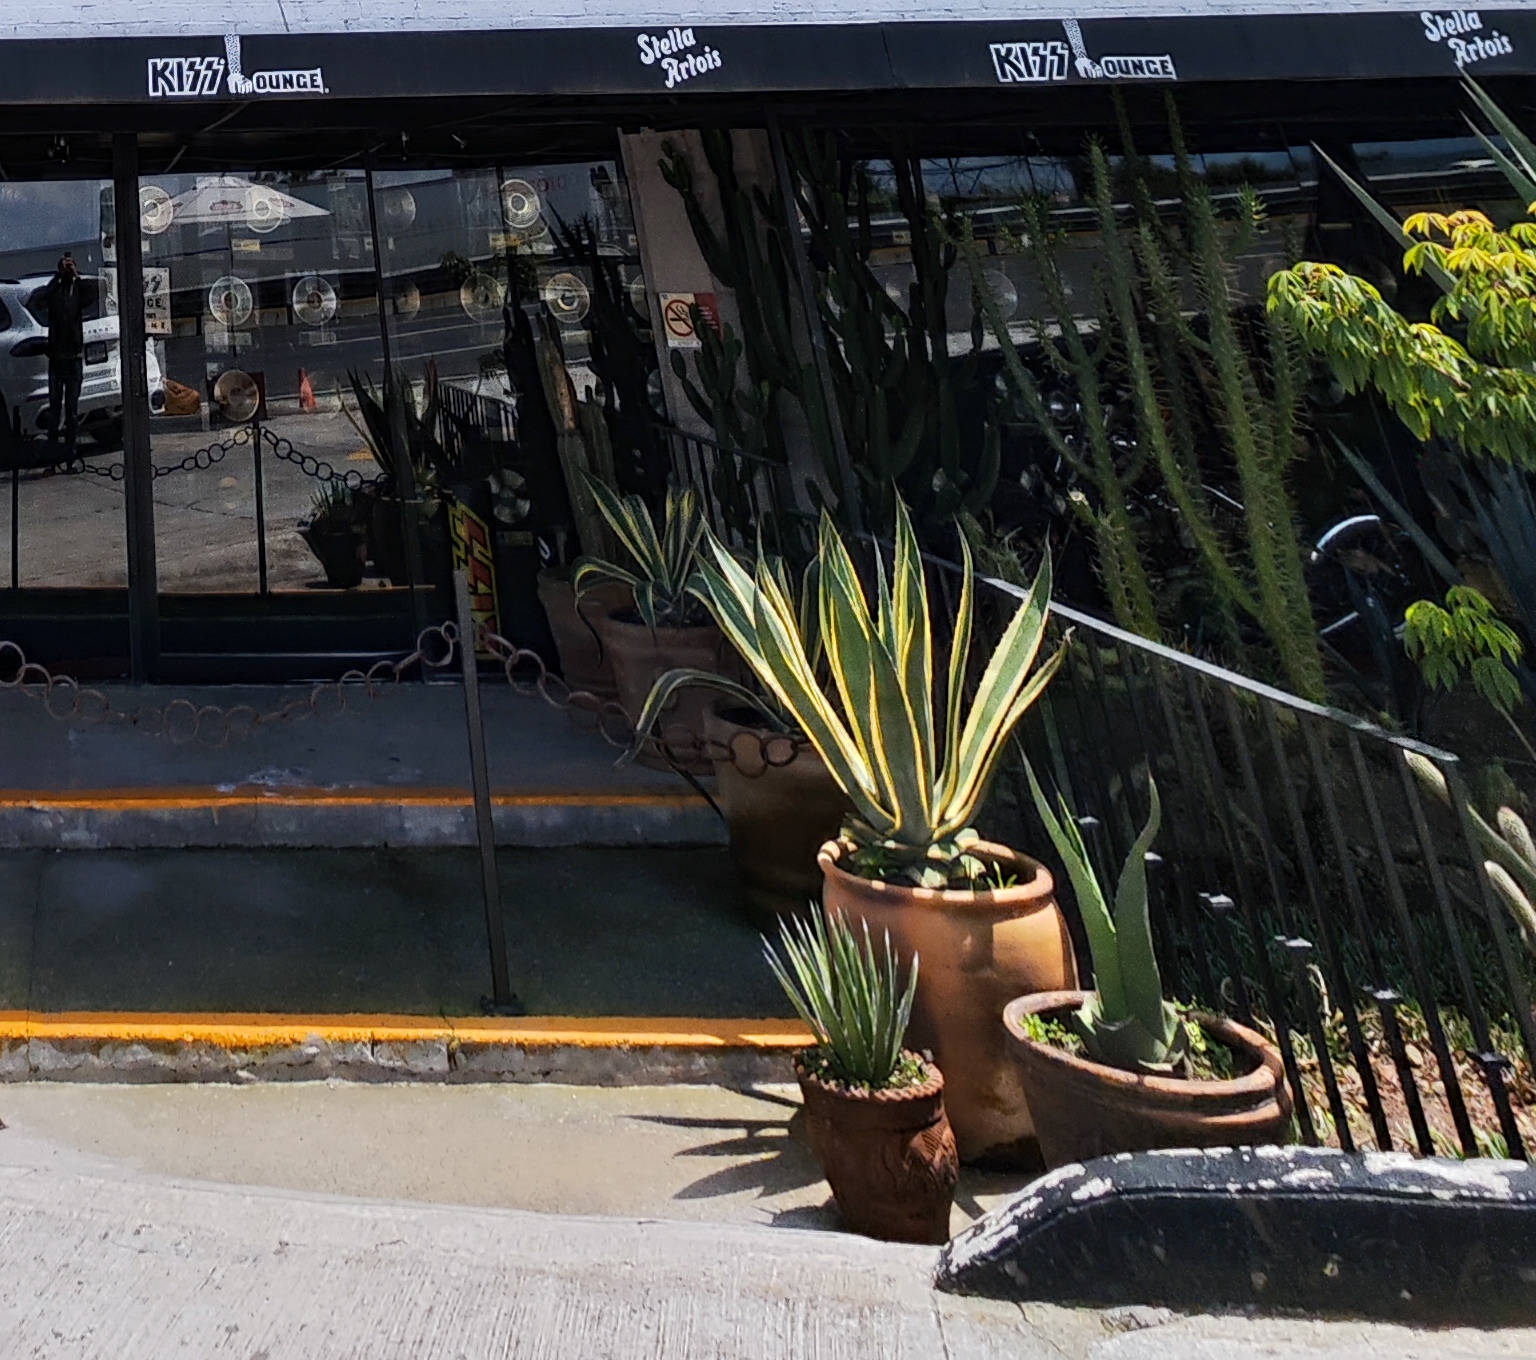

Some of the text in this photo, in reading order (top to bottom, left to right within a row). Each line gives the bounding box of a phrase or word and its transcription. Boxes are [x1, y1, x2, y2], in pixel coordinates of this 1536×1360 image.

[1420, 8, 1483, 42] Stella
[637, 27, 696, 65] Stella
[989, 41, 1069, 83] KISS
[1448, 30, 1513, 68] Artois
[148, 57, 225, 96] KISS
[661, 45, 722, 88] Artois
